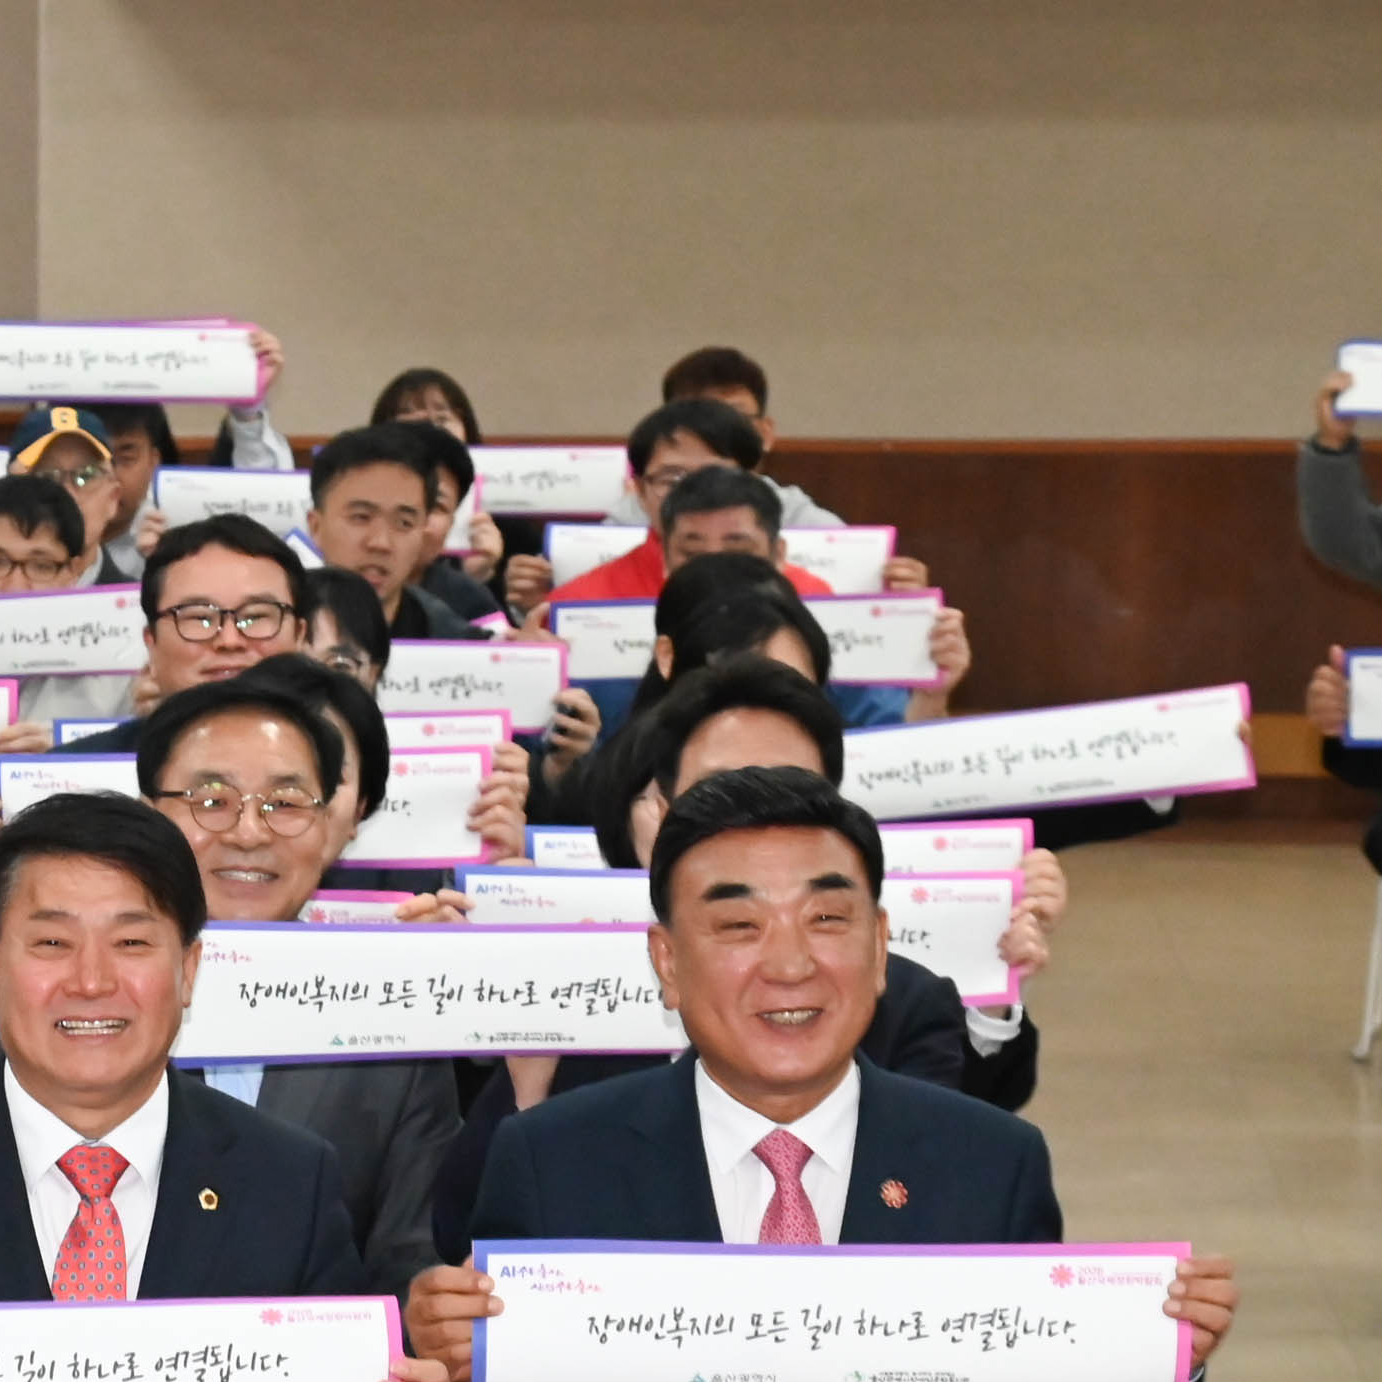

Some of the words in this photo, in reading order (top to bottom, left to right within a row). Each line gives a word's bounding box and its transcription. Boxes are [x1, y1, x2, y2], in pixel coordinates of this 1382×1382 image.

[239, 976, 369, 1013] 장애인복지의
[378, 979, 417, 1009] 모든
[427, 973, 464, 1016] 길이
[473, 978, 540, 1007] 하나로
[587, 1306, 735, 1349] 장애인복지의
[745, 1311, 790, 1344] 모든
[800, 1303, 842, 1352] 길이
[853, 1308, 929, 1342] 하나로
[940, 1306, 1076, 1353] 연결됩니다.
[66, 1351, 144, 1382] 하나로
